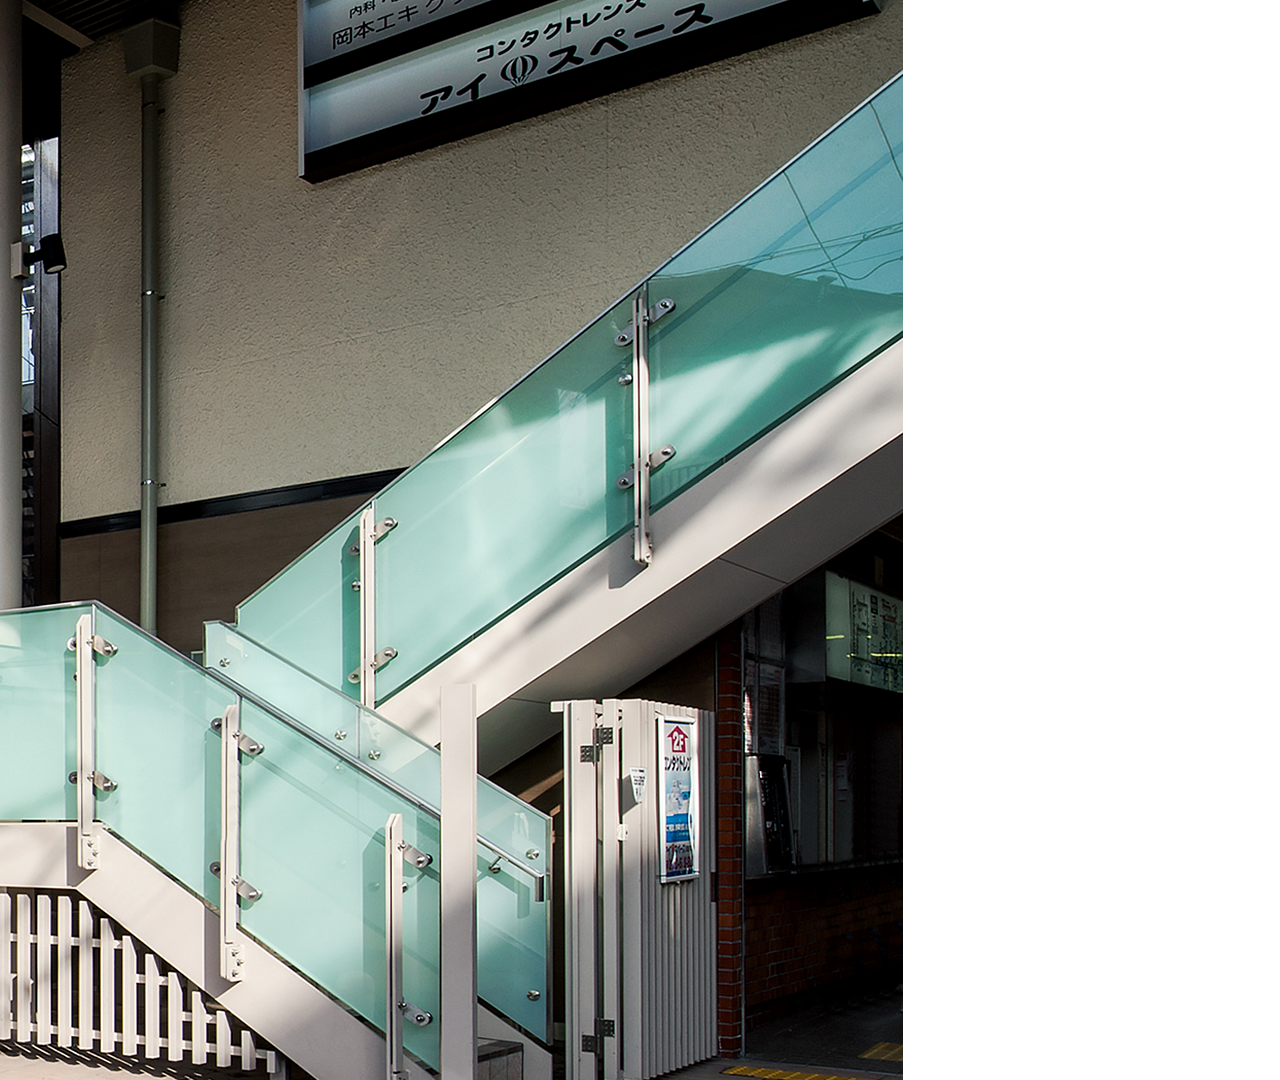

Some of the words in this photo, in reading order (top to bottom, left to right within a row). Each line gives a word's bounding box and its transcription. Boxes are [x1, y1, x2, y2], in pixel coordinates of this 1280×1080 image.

[546, 2, 714, 75] スペース
[672, 731, 684, 751] 2F
